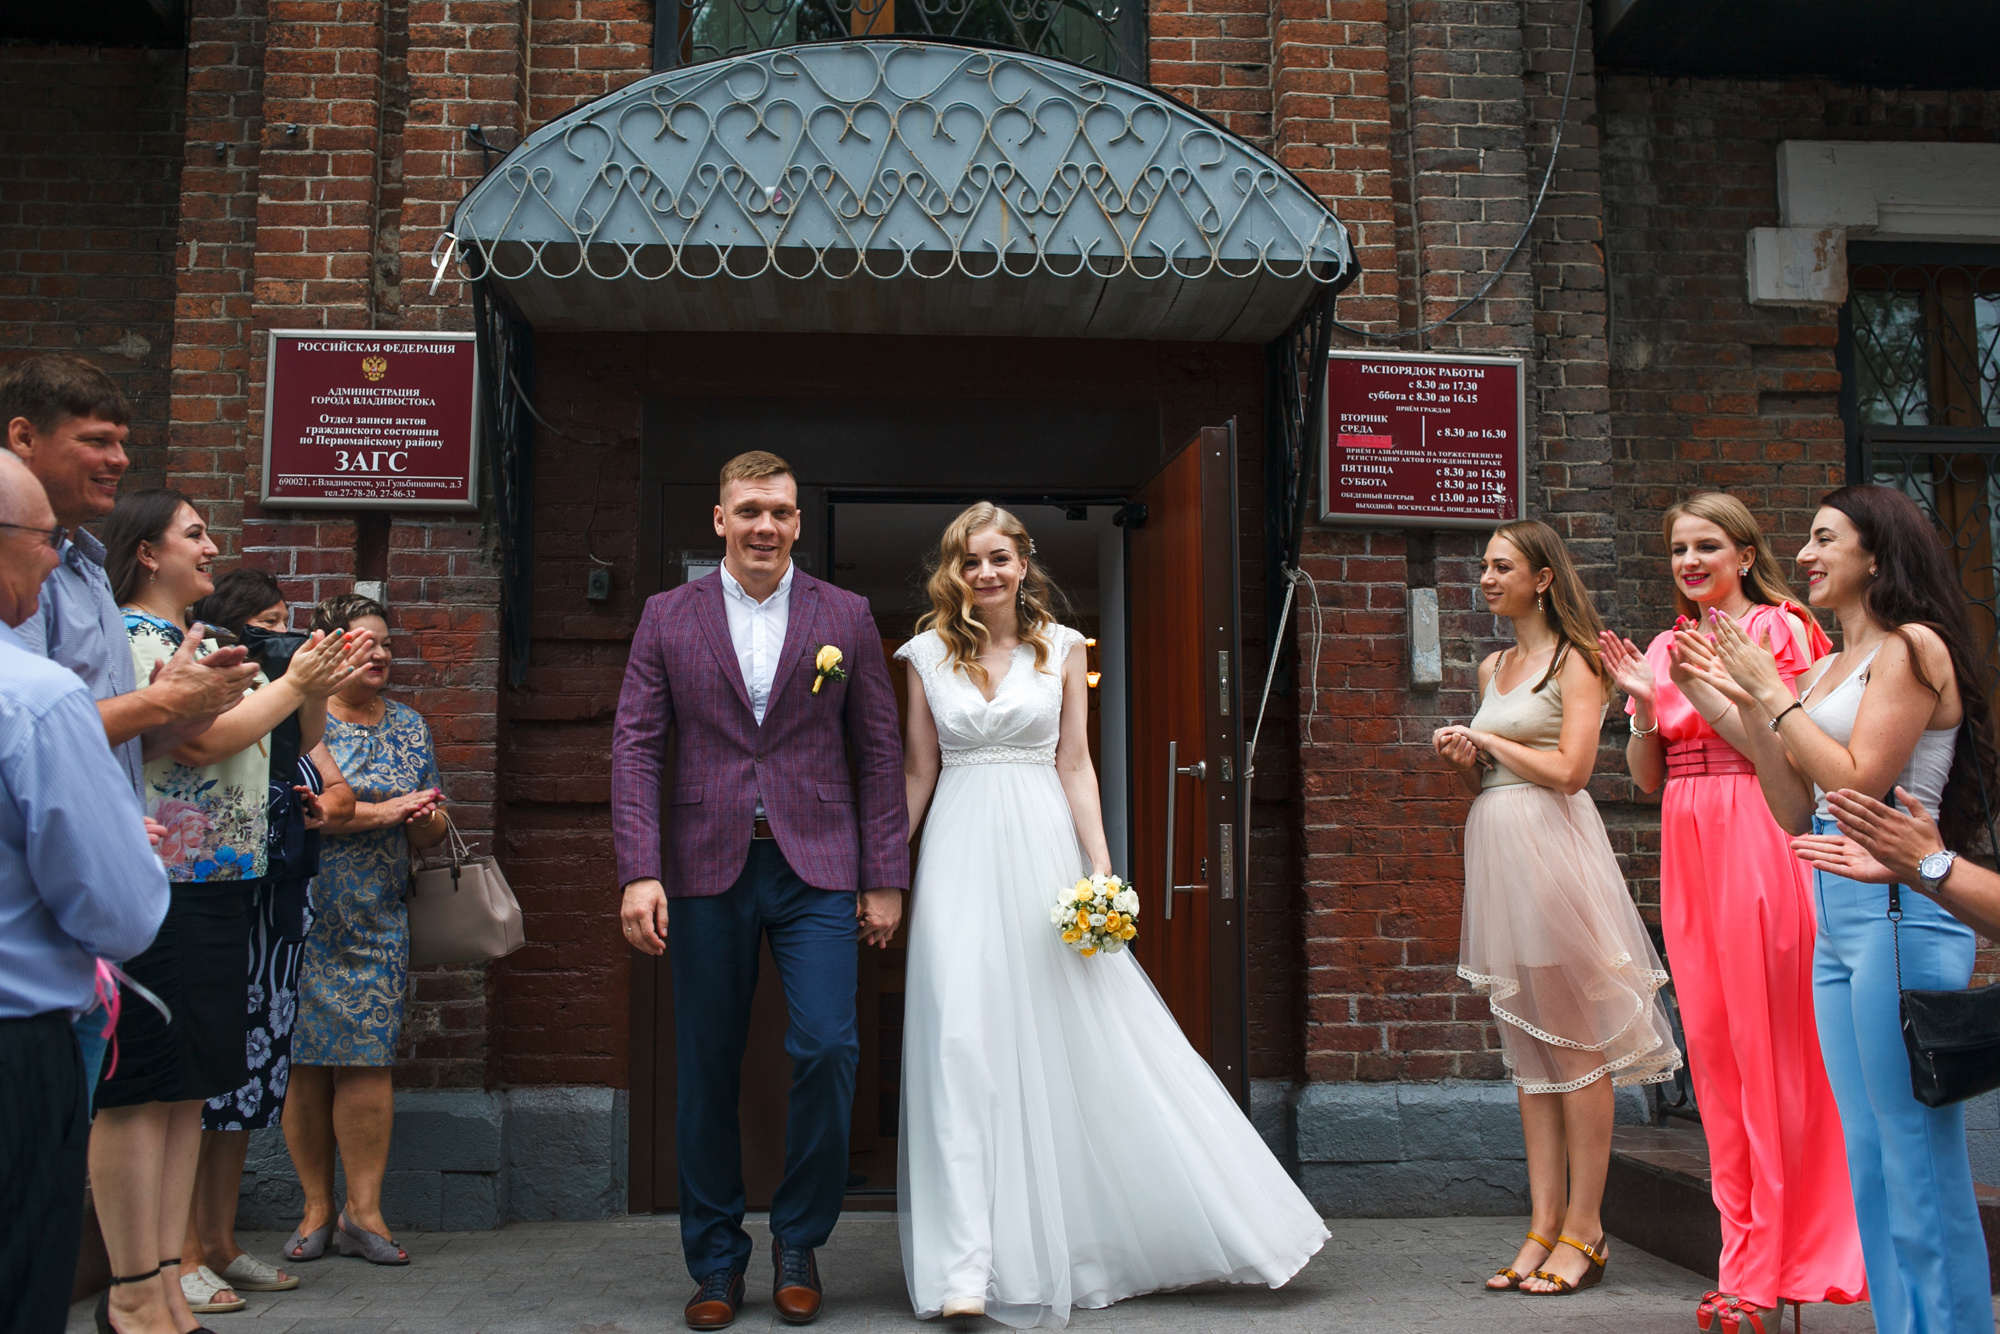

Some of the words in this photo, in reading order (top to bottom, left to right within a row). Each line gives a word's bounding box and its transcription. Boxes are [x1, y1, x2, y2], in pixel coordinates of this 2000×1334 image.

[297, 341, 380, 352] РОССИЙСКАЯ
[383, 343, 455, 354] ФЕДЕРАЦИЯ
[1361, 365, 1436, 376] РАСПОРЯДОК
[1439, 368, 1484, 378] РАБОТЫ
[1416, 380, 1435, 390] 8.30
[1453, 381, 1477, 391] 17.30
[328, 388, 420, 397] АДМИНИСТРАЦИЯ
[1369, 391, 1406, 400] суббота
[1416, 392, 1436, 402] 8.30
[1453, 394, 1478, 403] 16.15
[311, 396, 350, 405] ГОРОДА
[353, 397, 436, 406] ВЛАДИВОСТОКА
[319, 414, 352, 424] Отдел
[1341, 414, 1388, 423] ВТОРНИК
[306, 426, 381, 436] гражданского
[384, 428, 439, 436] состояния
[1340, 425, 1372, 434] СРЕДА
[1445, 428, 1464, 438] 8.30
[1482, 429, 1506, 438] 16.30
[316, 436, 402, 448] Первомайскому
[405, 439, 444, 449] району
[334, 450, 408, 472] ЗАГС
[1347, 455, 1399, 463] РЕГИСТРАЦИЮ
[1341, 465, 1393, 474] ПЯТНИЦА
[1444, 467, 1463, 476] 8.30
[1481, 469, 1506, 478] 16.30
[279, 478, 310, 487] 690021,
[312, 479, 373, 487] г.Владивосток,
[376, 480, 447, 489] ул.Гульбиновича,
[1341, 477, 1387, 487] СУББОТА
[1444, 480, 1464, 489] 8.30
[380, 490, 416, 498] 27-86-32
[1439, 493, 1464, 502] 13.00
